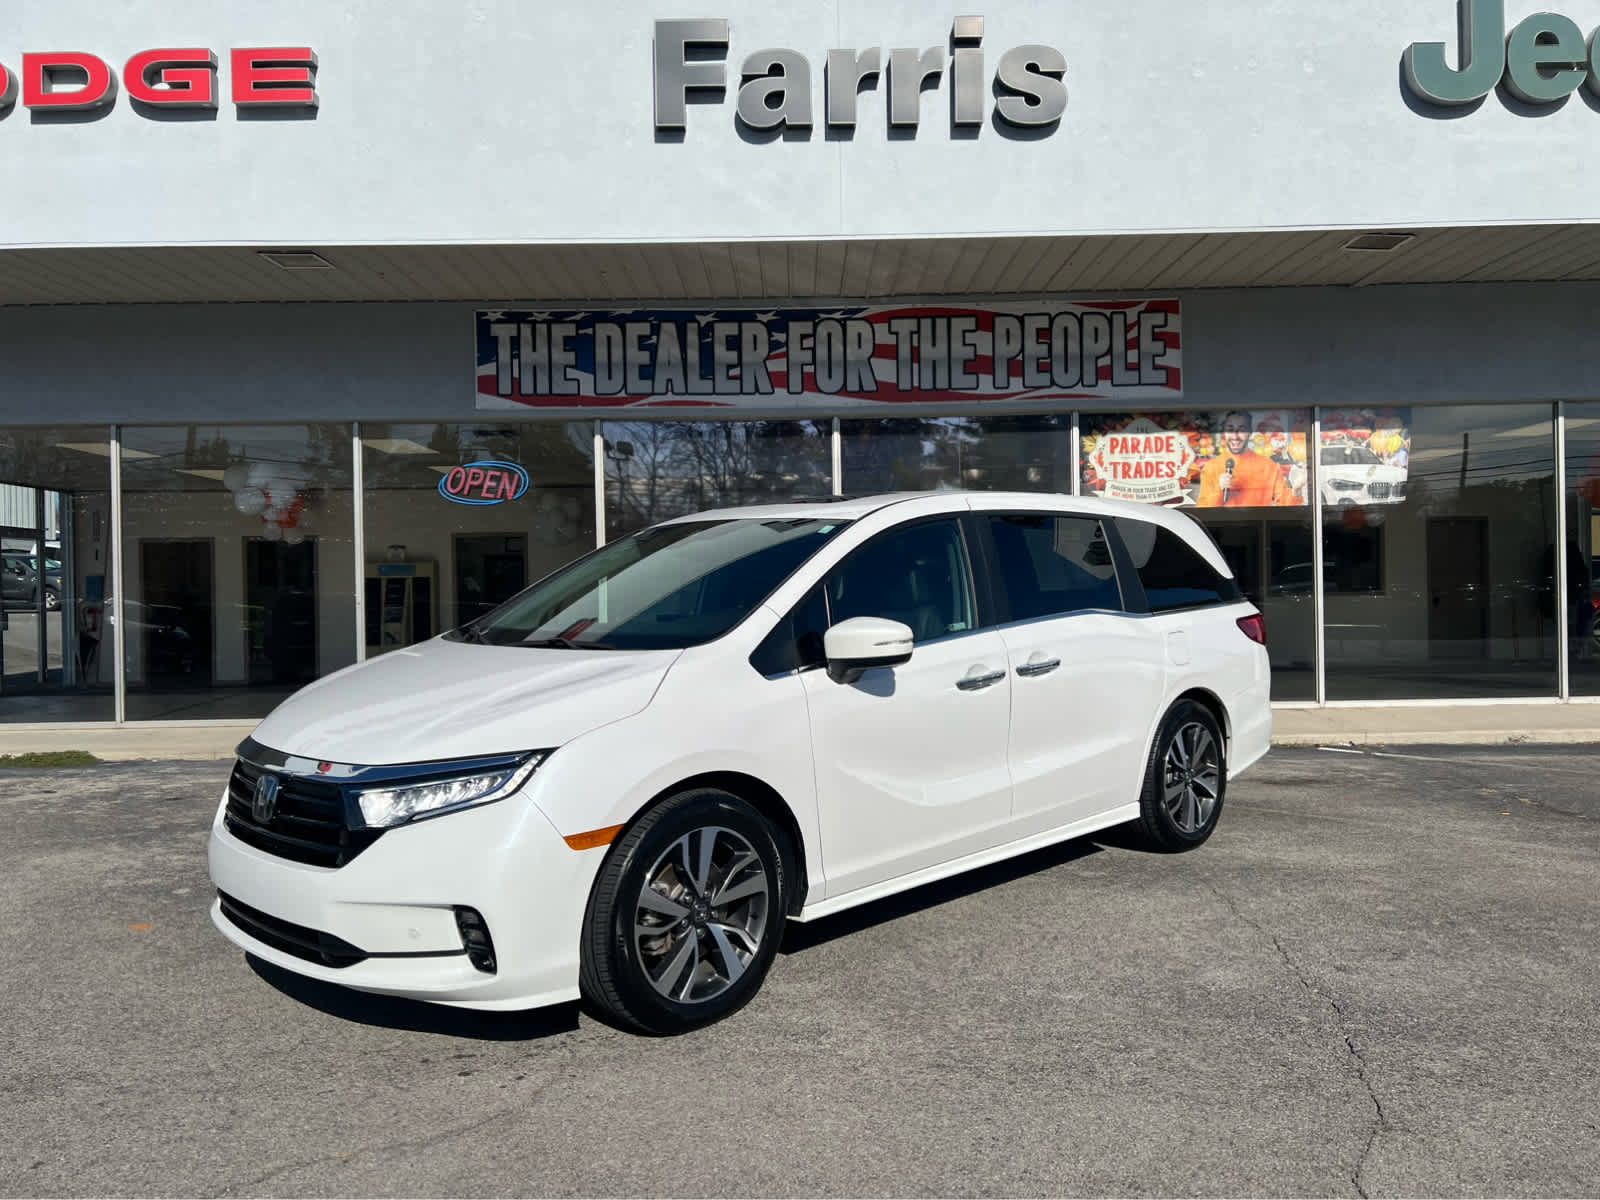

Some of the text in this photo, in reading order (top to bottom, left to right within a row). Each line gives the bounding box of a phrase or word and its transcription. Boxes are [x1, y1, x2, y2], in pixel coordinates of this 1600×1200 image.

[0, 47, 317, 108] DGE
[654, 15, 1069, 129] Farris
[1405, 0, 1600, 101] Je
[490, 311, 1169, 396] THE DEALER FOR THE PEOPLE
[1109, 435, 1176, 455] PARADE
[1109, 460, 1176, 480] TRADES
[446, 466, 520, 501] OPEN
